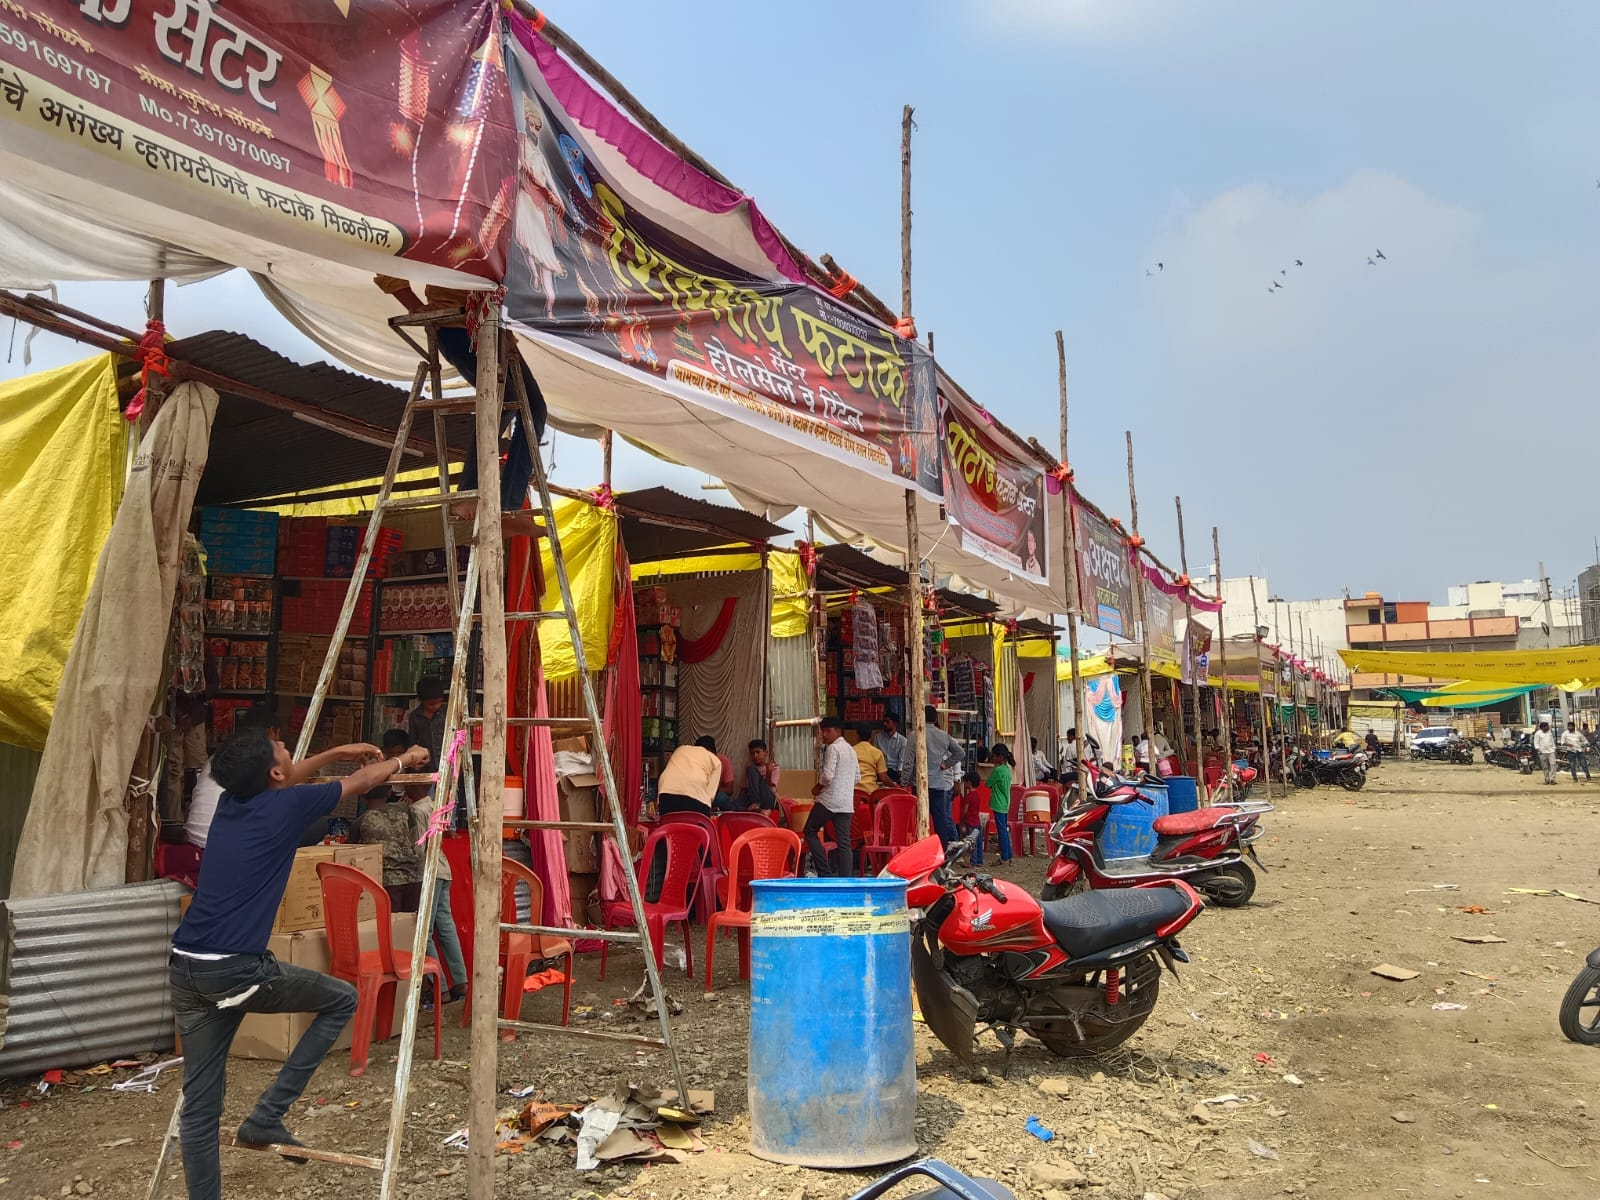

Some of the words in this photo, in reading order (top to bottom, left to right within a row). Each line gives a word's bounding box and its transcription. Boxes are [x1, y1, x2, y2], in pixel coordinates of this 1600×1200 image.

[39, 97, 124, 151] असंख्य
[132, 134, 250, 200] व्हरायटीजचे
[256, 185, 315, 222] फटाके
[321, 204, 392, 249] मिळतील.
[704, 335, 797, 406] होलसेल
[799, 385, 816, 414] व
[769, 346, 808, 385] सेंटर
[790, 305, 906, 409] फटाके
[1088, 537, 1123, 589] अक्षय
